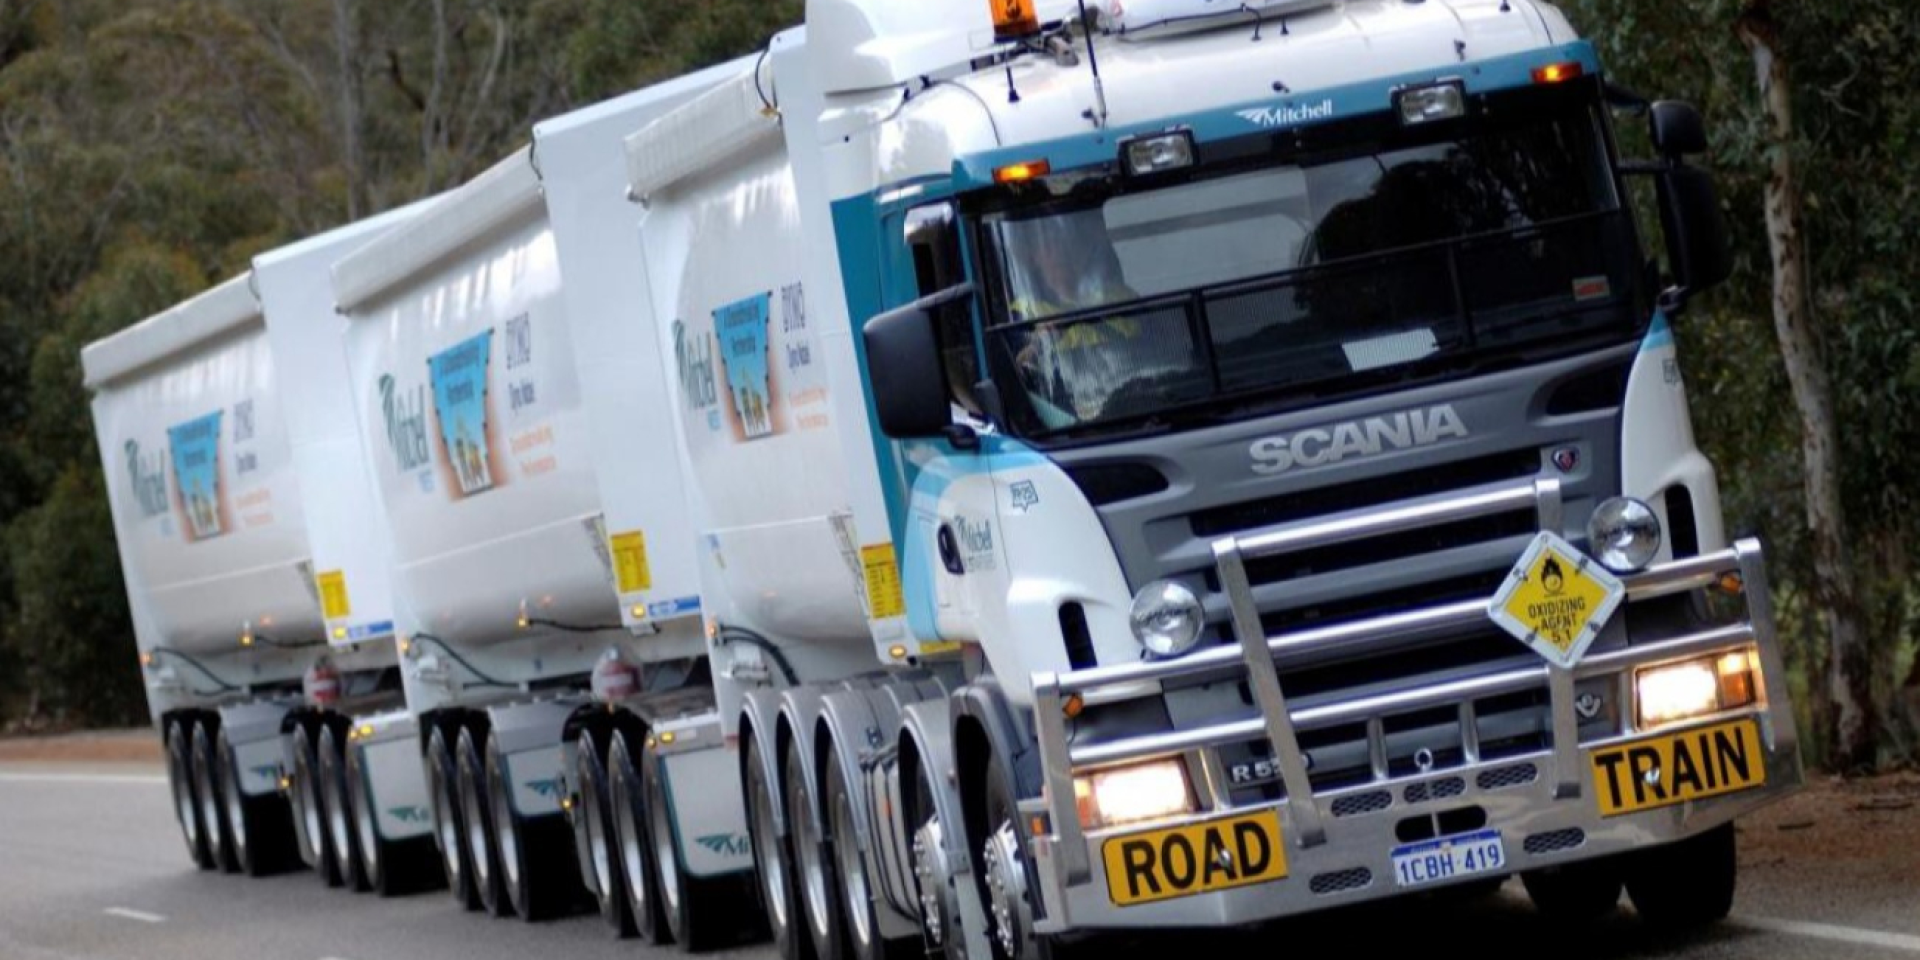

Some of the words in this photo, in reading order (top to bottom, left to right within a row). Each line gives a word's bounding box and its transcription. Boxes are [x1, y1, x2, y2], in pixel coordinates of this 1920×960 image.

[1261, 99, 1333, 127] Mitchell
[1249, 403, 1469, 476] SCANIA
[1528, 596, 1585, 619] OXIDIZING
[1540, 612, 1577, 631] AGENT
[1232, 764, 1250, 782] R
[1595, 727, 1750, 808] TRAIN
[1122, 820, 1272, 897] ROAD
